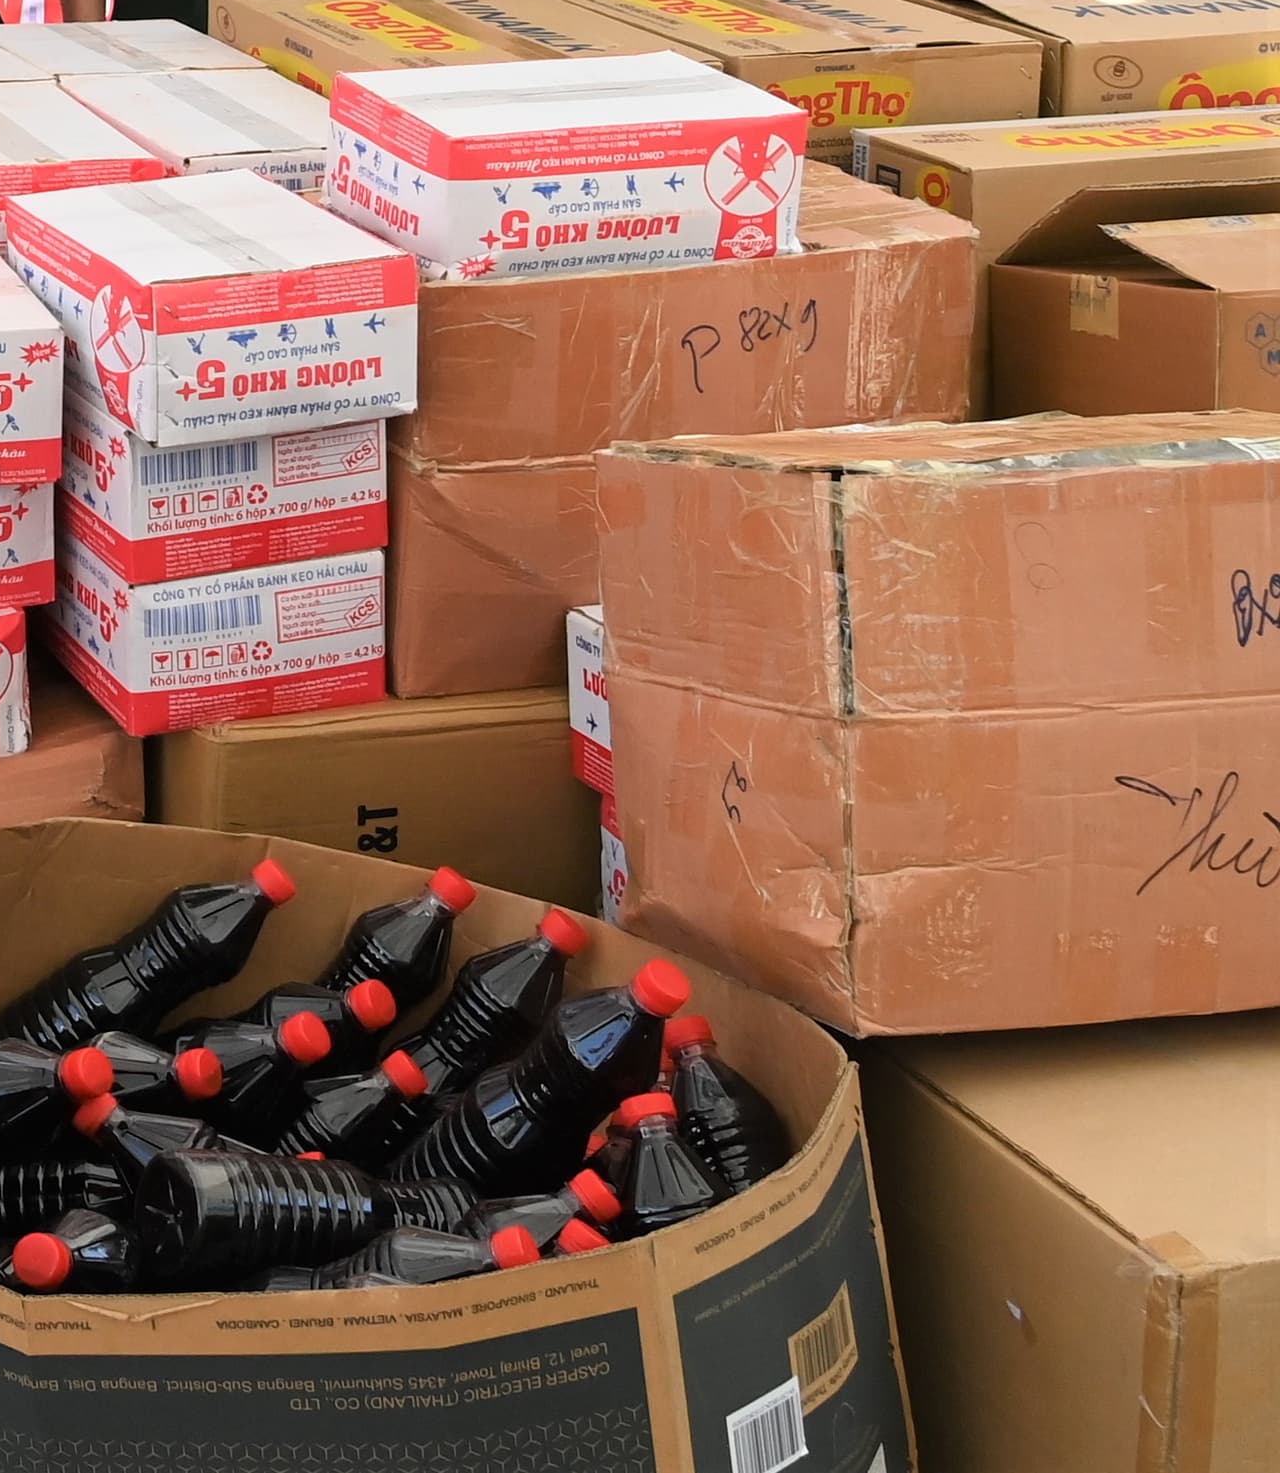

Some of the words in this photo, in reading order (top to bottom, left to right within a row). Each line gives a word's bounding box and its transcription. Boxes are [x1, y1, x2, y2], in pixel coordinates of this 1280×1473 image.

[449, 0, 606, 53] VINAMILK
[536, 221, 589, 249] KHÔ
[595, 215, 680, 239] LƯƠNG
[543, 1353, 565, 1366] 12,
[571, 1343, 608, 1362] Level
[450, 1367, 497, 1384] Tower,
[500, 1357, 540, 1377] Bhiraj
[545, 1361, 610, 1388] CASPER
[324, 1377, 403, 1393] Sukhumvit,
[412, 1376, 446, 1389] 4345
[463, 1374, 543, 1402] ELECTRIC
[290, 1399, 320, 1411] LTD
[325, 1397, 360, 1411] CO.,
[365, 1391, 460, 1410] (THAILAND)
